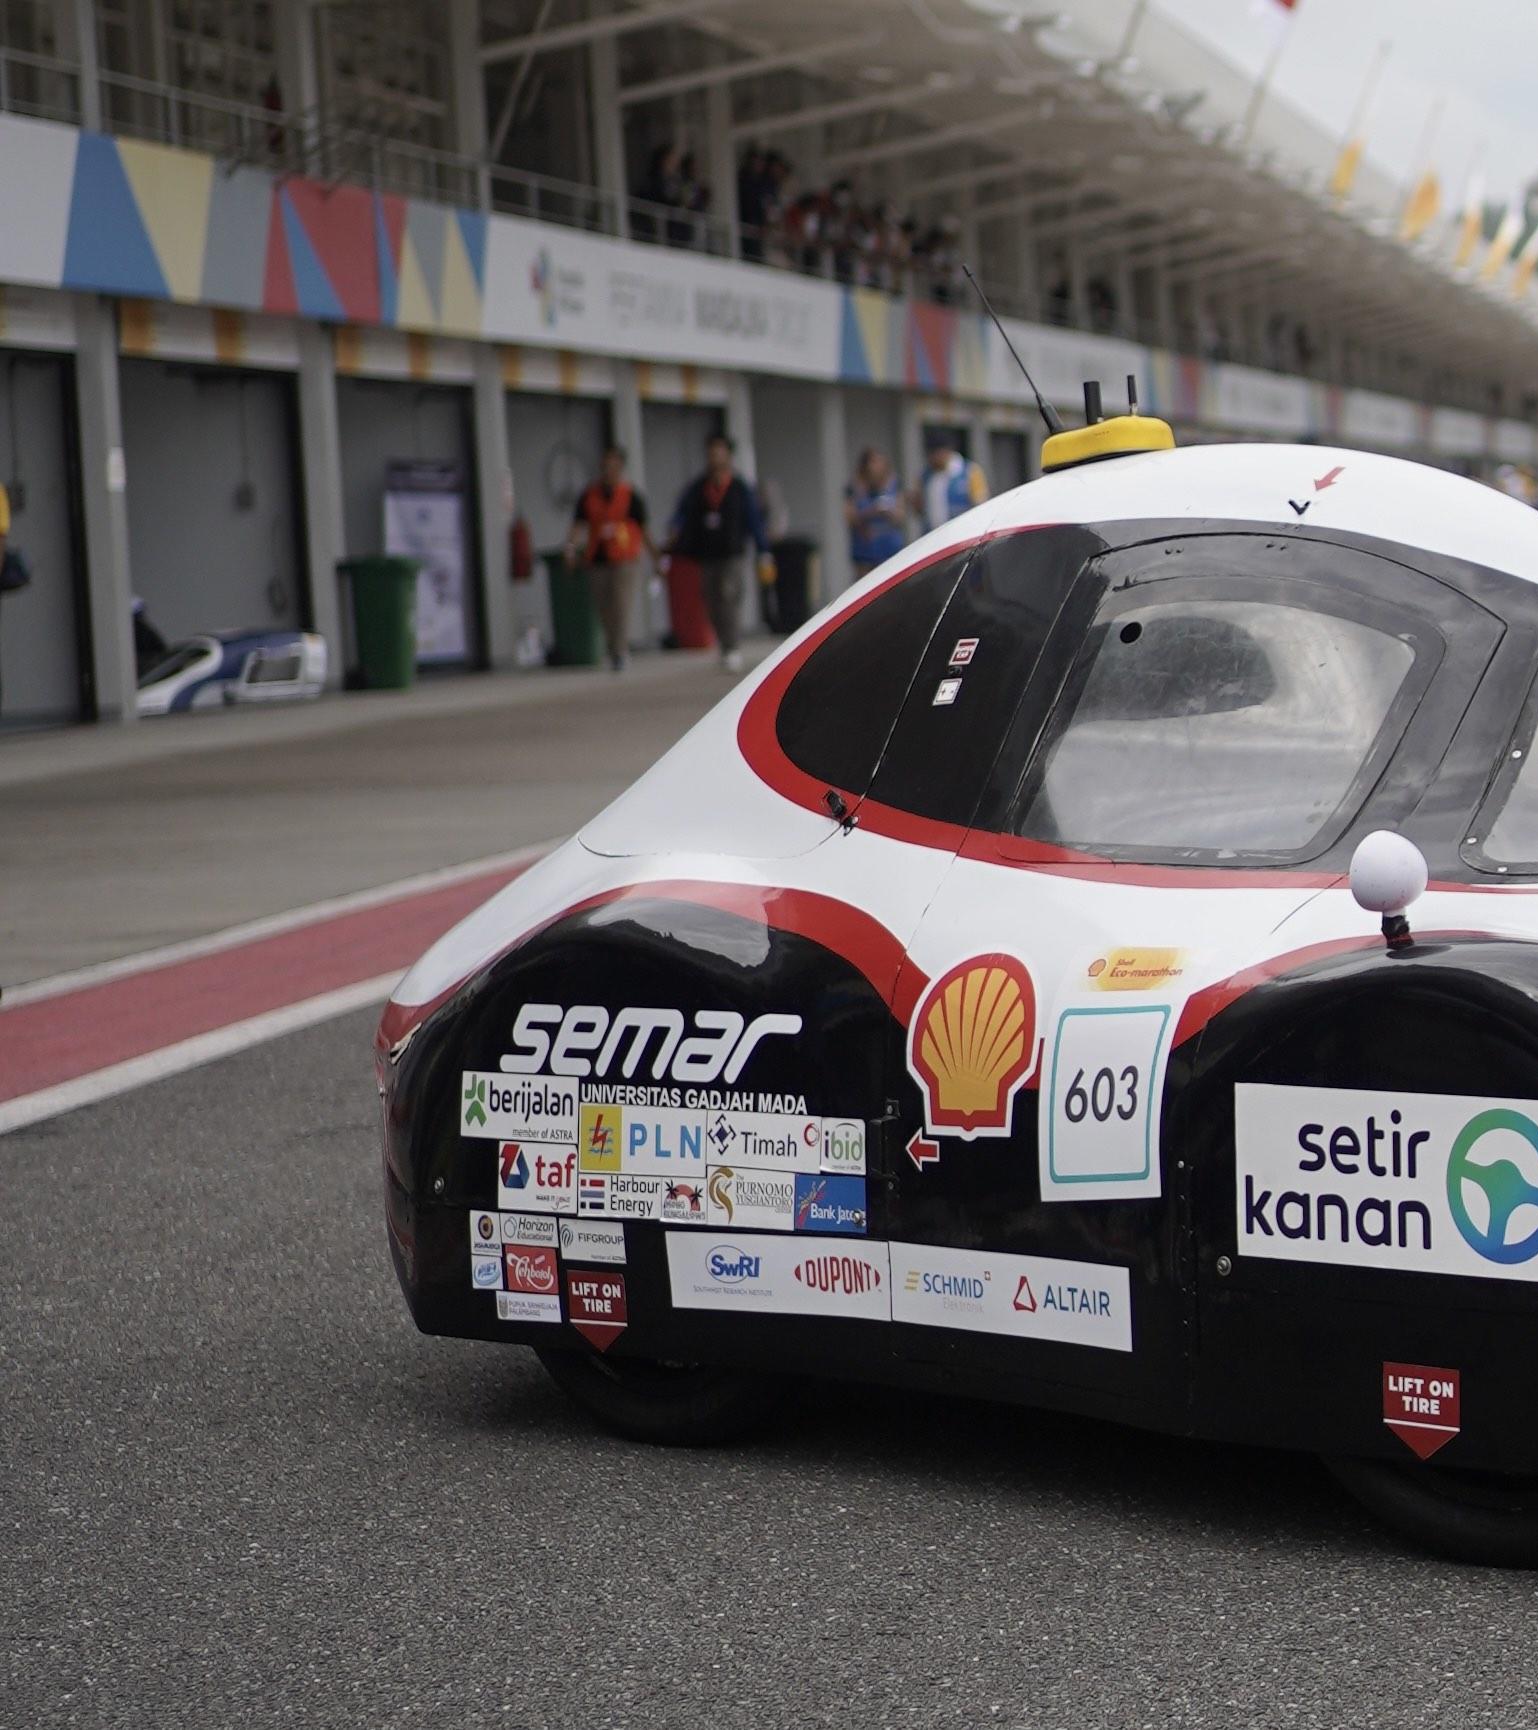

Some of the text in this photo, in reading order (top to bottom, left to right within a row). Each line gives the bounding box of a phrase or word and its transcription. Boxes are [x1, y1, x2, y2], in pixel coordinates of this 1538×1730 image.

[1109, 966, 1183, 978] Eco-marathon
[499, 1003, 803, 1084] semar
[489, 1079, 574, 1123] berijalan
[581, 1083, 808, 1116] UNIVERSITAS GADJAH MADA
[1064, 1065, 1139, 1123] 603
[512, 1128, 574, 1141] member of ASTRA
[629, 1122, 702, 1159] PLN
[740, 1131, 797, 1157] Timah
[824, 1130, 863, 1161] ibid
[1297, 1109, 1431, 1179] setir
[535, 1152, 577, 1188] taf
[610, 1175, 660, 1194] Harbour
[736, 1180, 793, 1198] PURNOMO
[610, 1194, 653, 1217] Energy
[810, 1203, 836, 1220] Bank
[1244, 1174, 1432, 1250] kanan
[518, 1216, 554, 1233] Horizon
[578, 1232, 625, 1245] FIFGROUP
[710, 1254, 760, 1278] SwRI
[806, 1256, 872, 1294] DUPONT
[571, 1281, 621, 1298] LIFT ON
[922, 1272, 984, 1299] SCHMID
[582, 1298, 613, 1313] TIRE
[1043, 1285, 1112, 1317] ALTAIR
[1388, 1375, 1454, 1398] LIFT ON
[1401, 1395, 1440, 1416] TIRE
